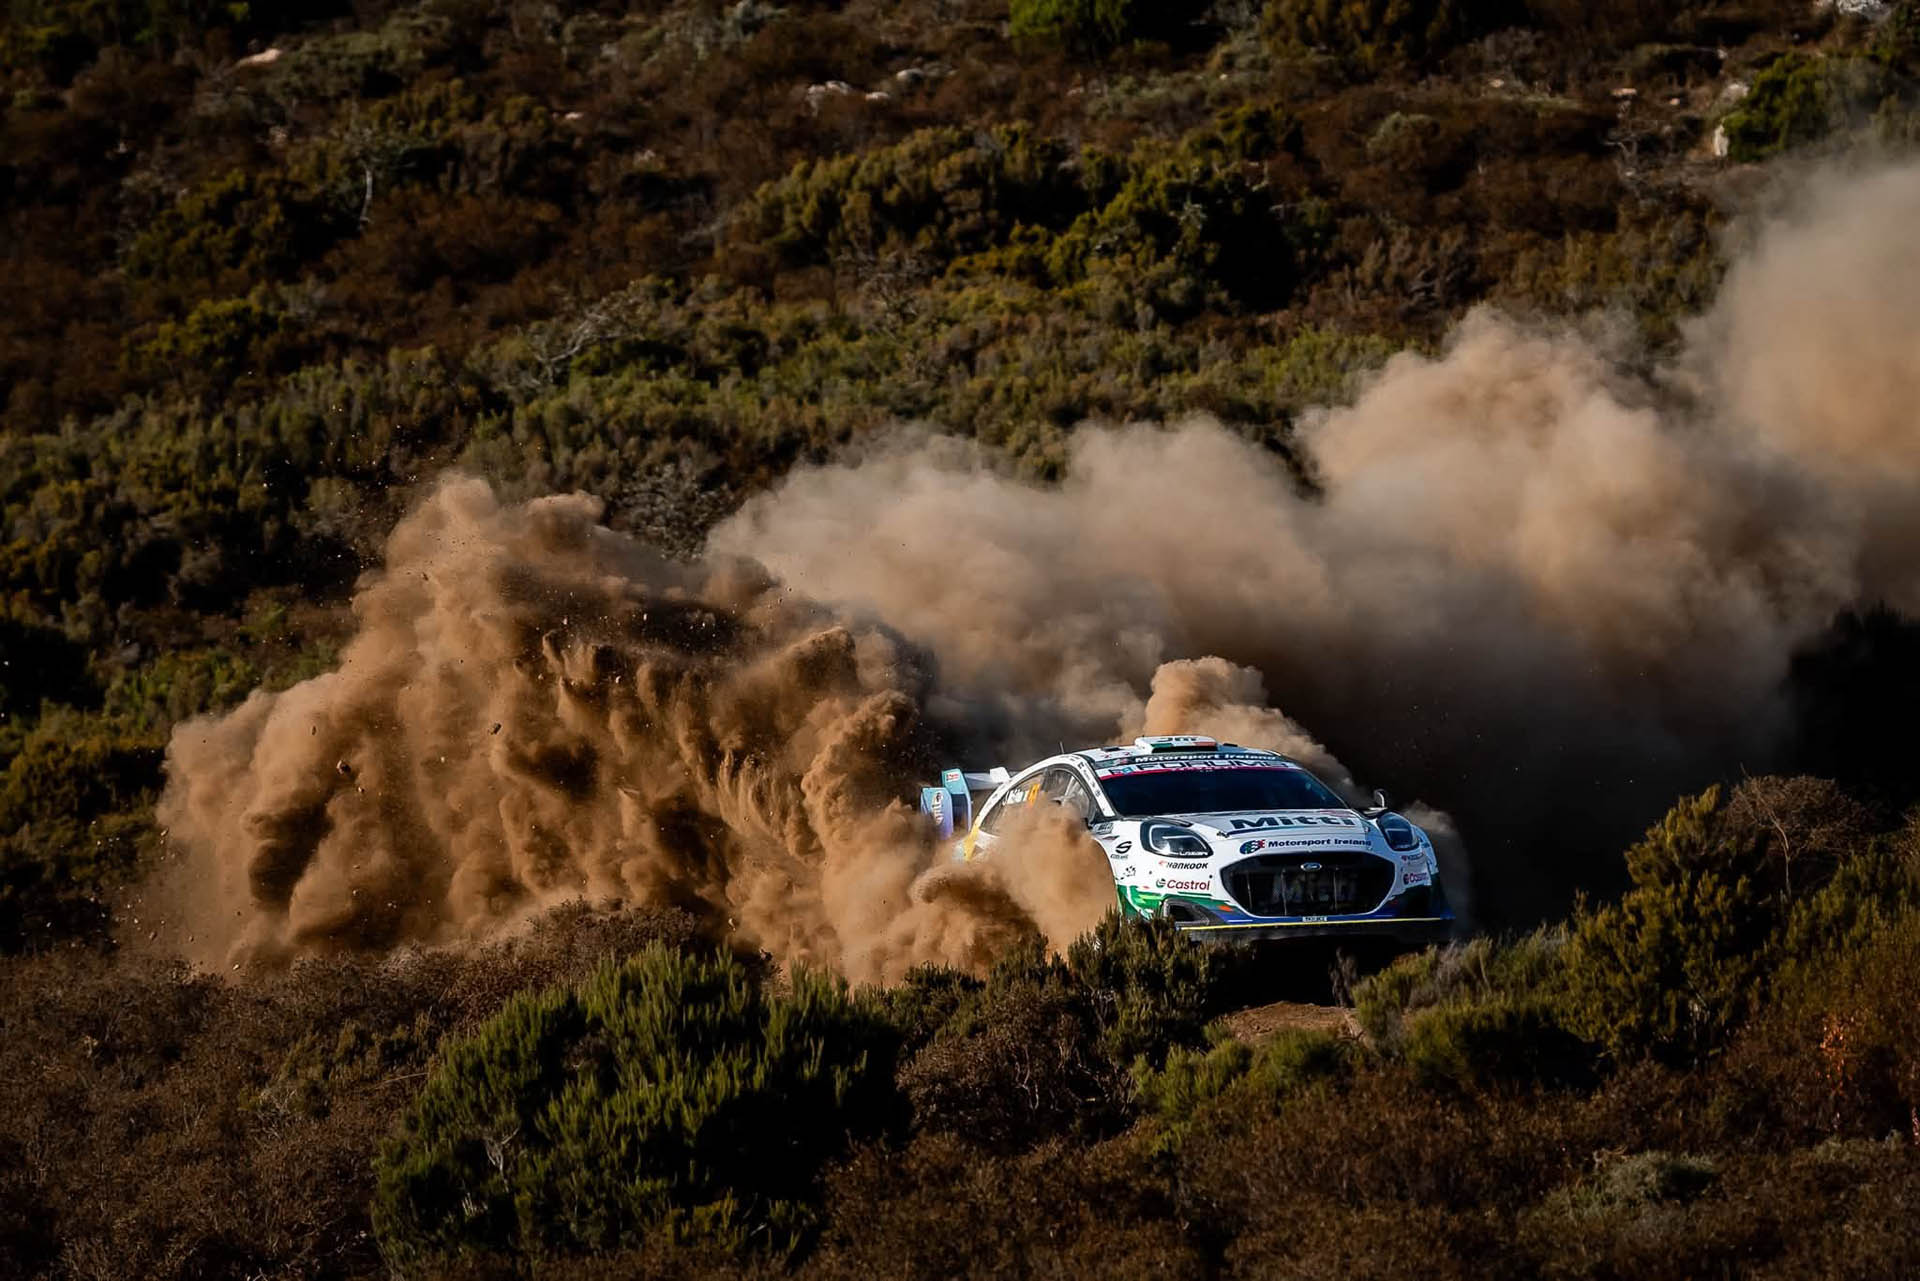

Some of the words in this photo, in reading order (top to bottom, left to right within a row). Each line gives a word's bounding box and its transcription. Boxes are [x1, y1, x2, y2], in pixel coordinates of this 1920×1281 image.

[1230, 816, 1355, 830] Mitti
[1268, 839, 1331, 848] Motorsport
[1334, 839, 1372, 847] Ireland
[1166, 879, 1211, 891] Castrol
